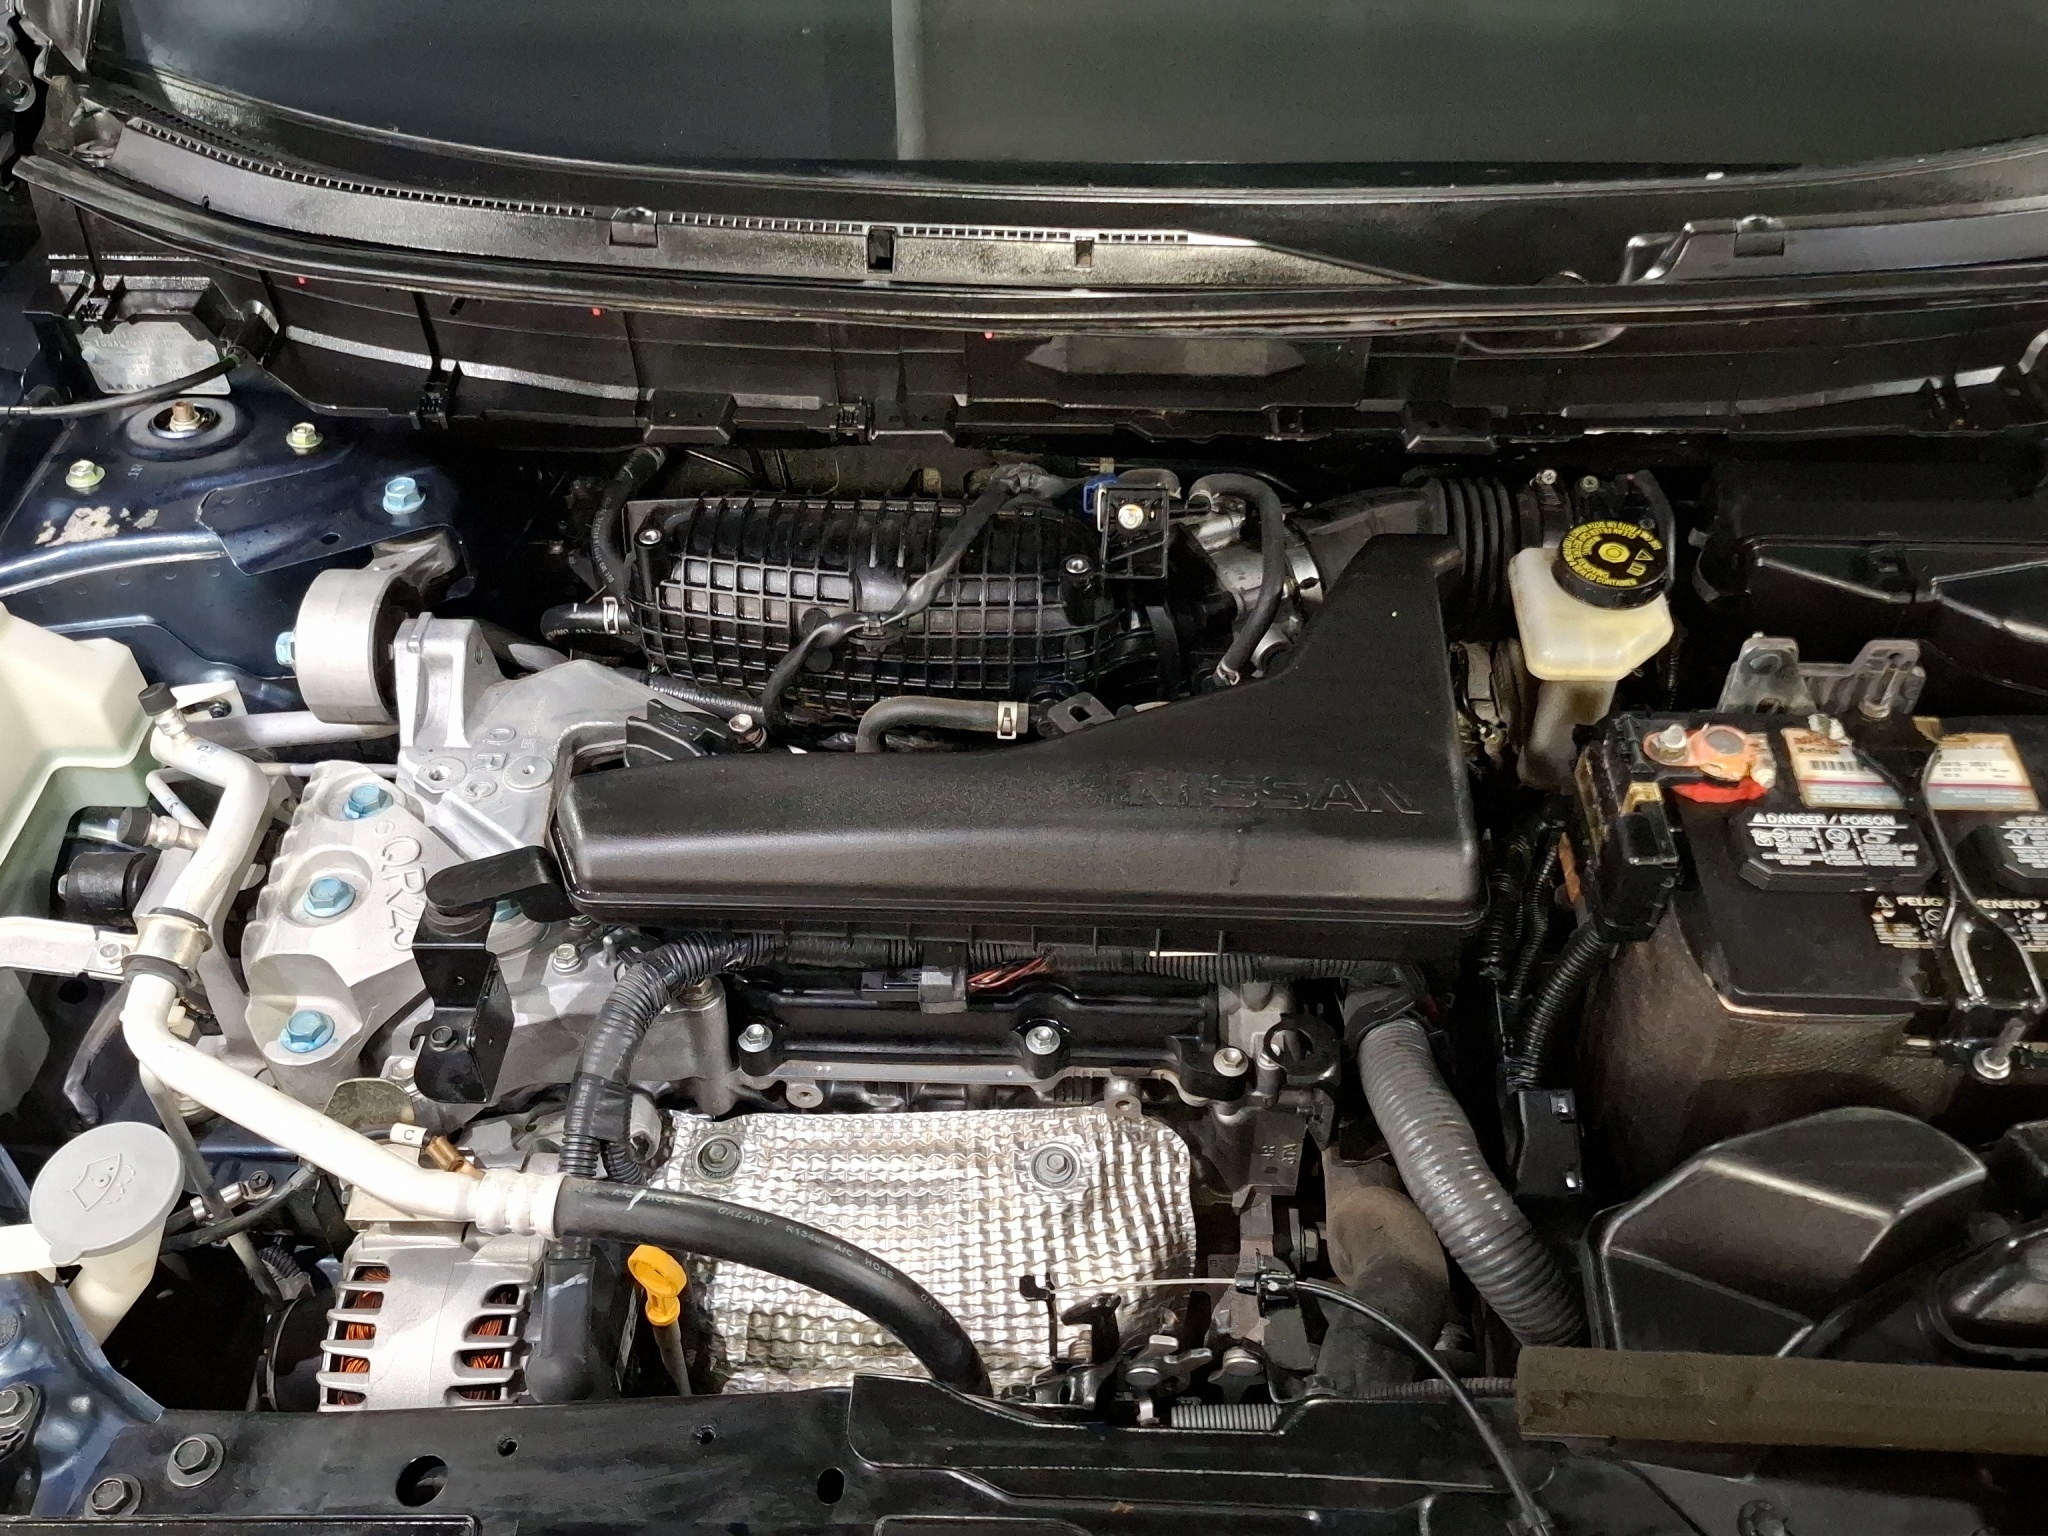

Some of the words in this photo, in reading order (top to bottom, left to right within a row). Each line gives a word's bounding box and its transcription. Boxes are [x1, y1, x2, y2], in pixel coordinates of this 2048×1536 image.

[1129, 771, 1425, 815] NISSAN
[1766, 813, 1826, 824] DANGER
[1841, 815, 1896, 825] POISON
[1896, 896, 1944, 907] PELIG
[404, 1129, 415, 1140] C
[717, 1205, 773, 1226] GALAXY
[833, 1243, 854, 1257] A/C
[864, 1257, 895, 1279] HOSE
